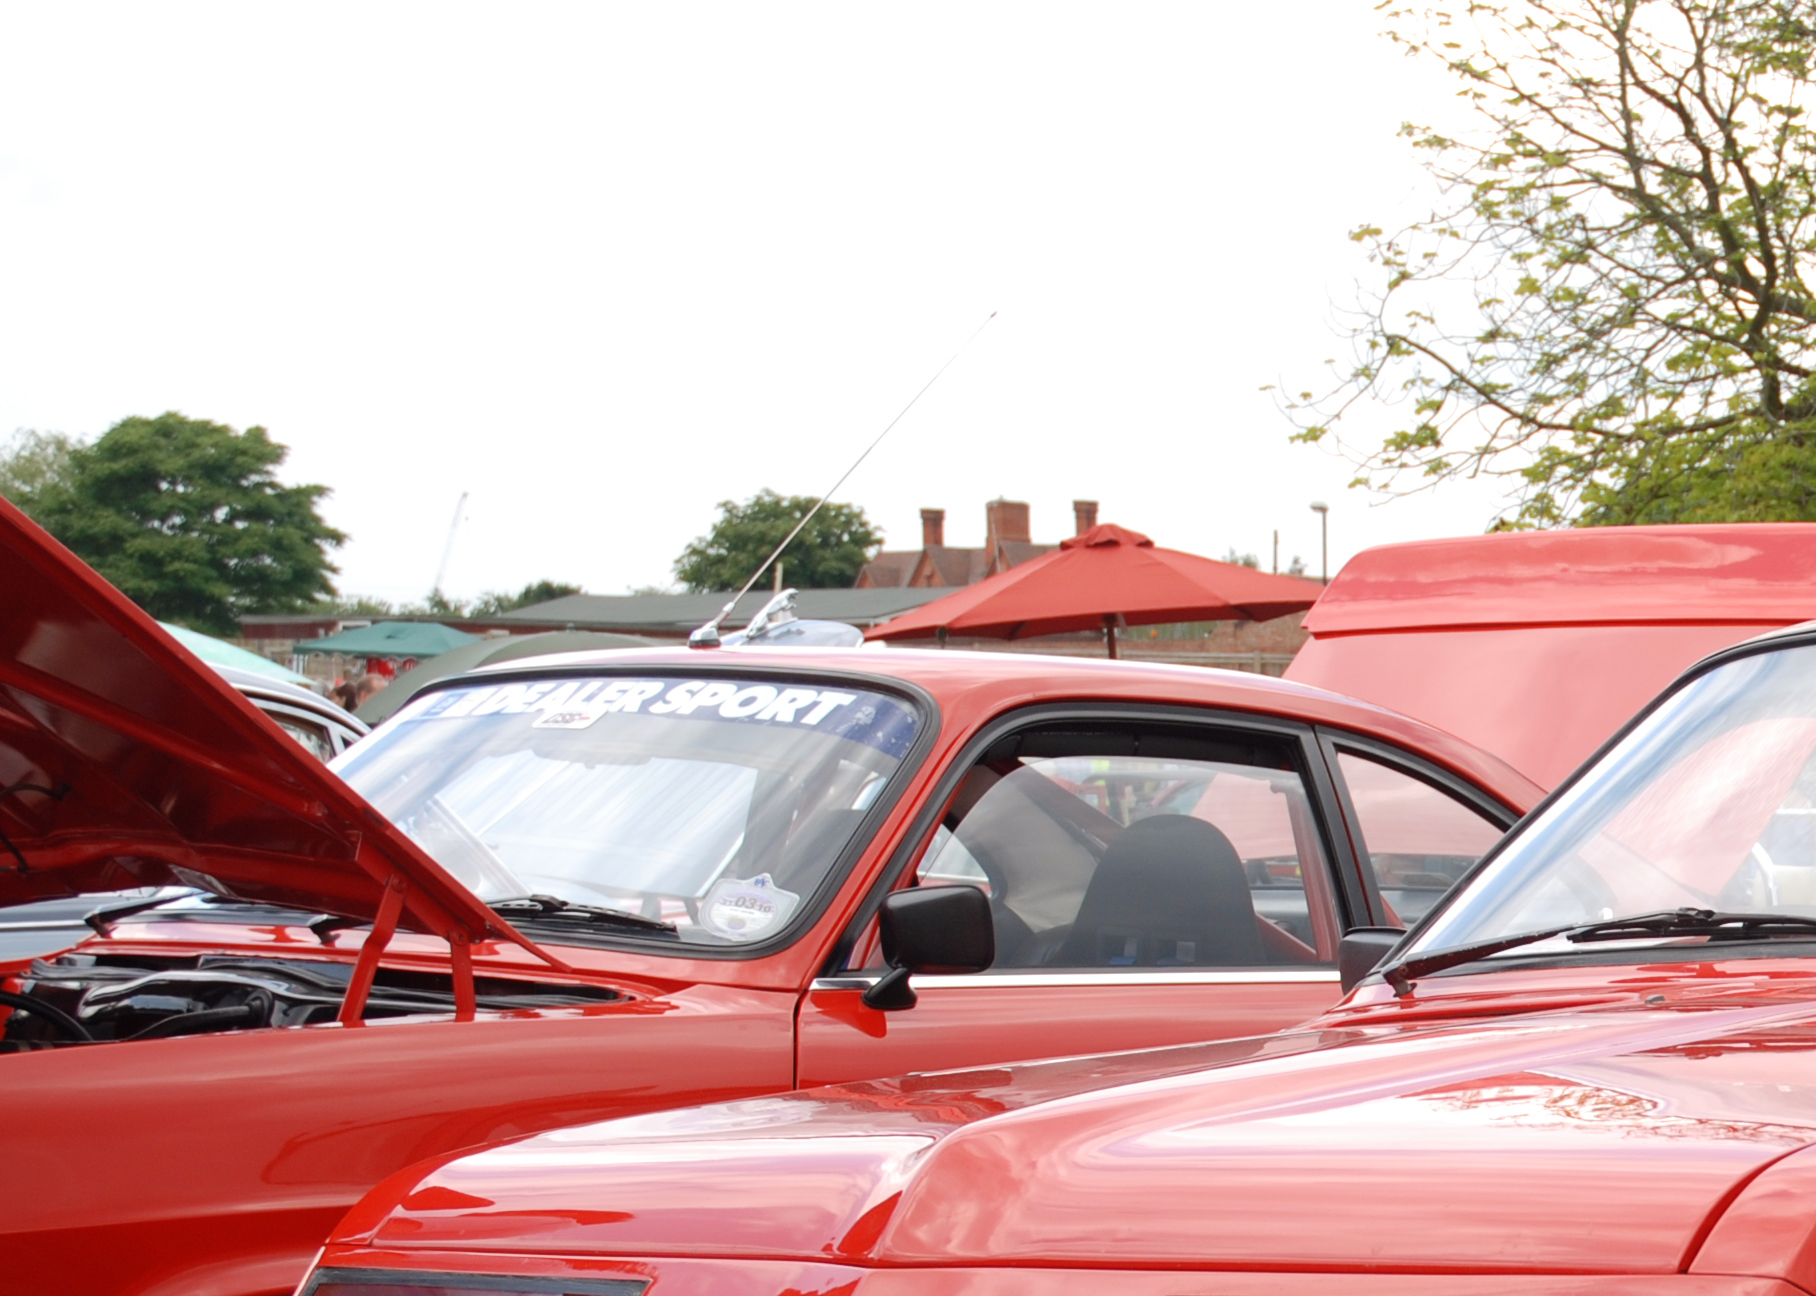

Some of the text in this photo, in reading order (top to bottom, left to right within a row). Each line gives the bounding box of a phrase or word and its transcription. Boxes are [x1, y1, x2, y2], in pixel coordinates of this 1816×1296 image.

[471, 681, 858, 726] DEALER SPORT
[735, 896, 757, 909] 03
